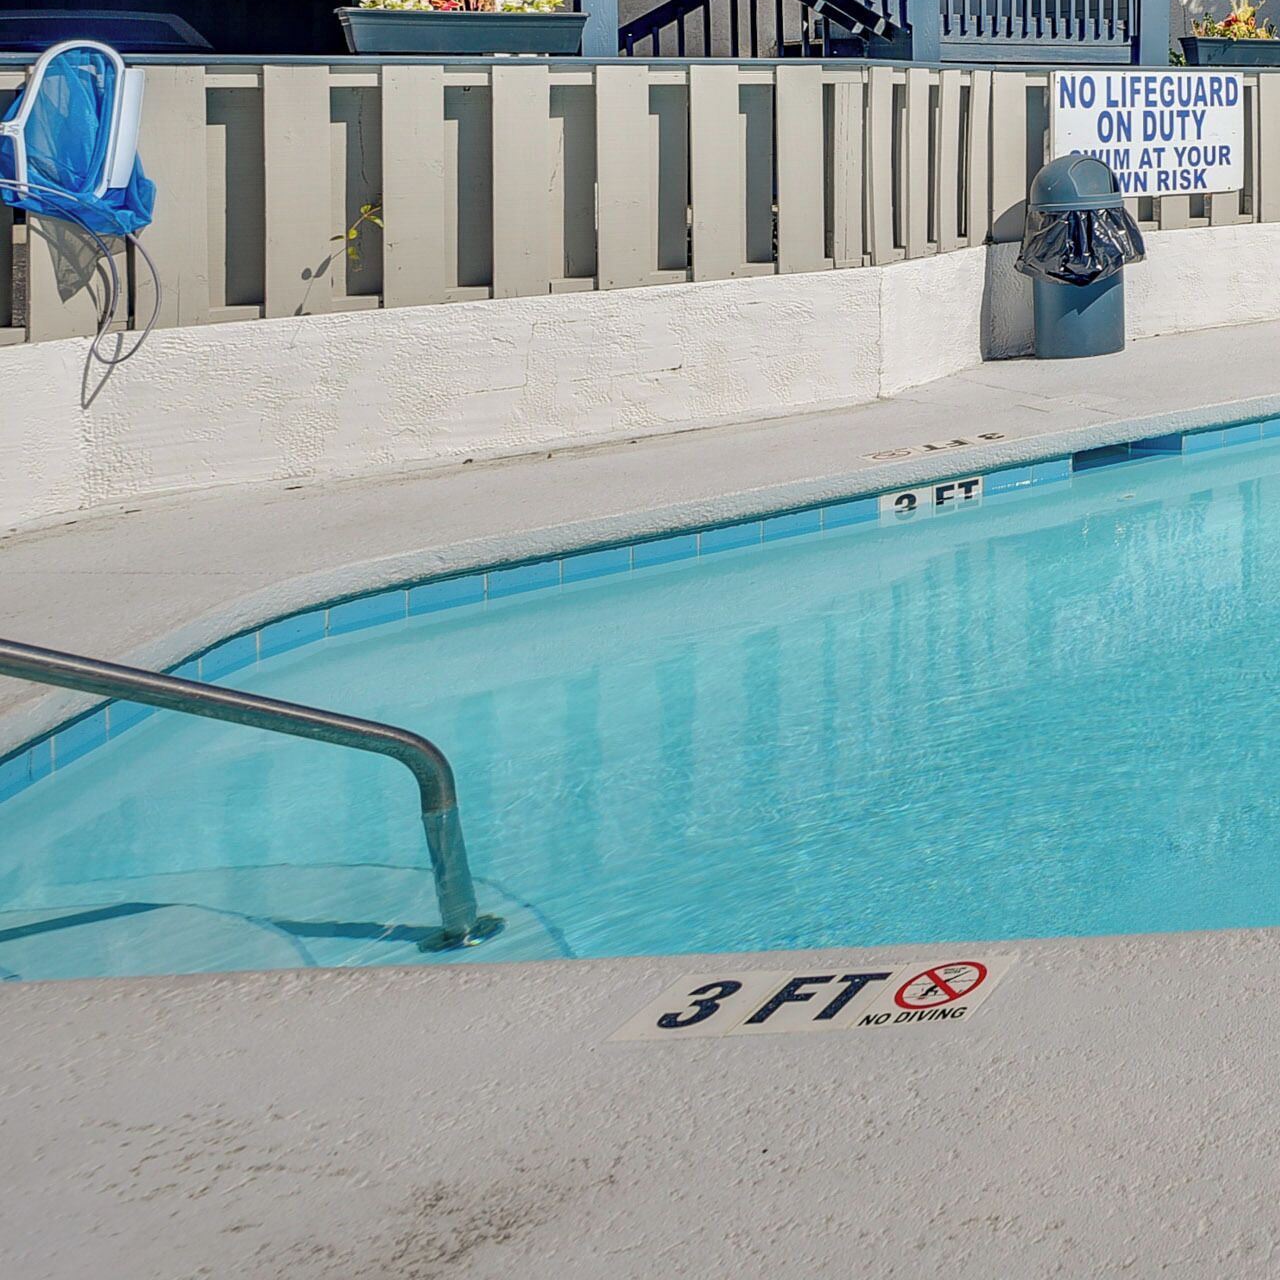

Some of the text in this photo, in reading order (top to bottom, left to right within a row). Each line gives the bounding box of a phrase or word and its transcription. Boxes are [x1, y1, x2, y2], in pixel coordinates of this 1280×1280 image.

[1060, 76, 1238, 109] NO LIFEGUARD
[1097, 110, 1206, 143] ON DUTY
[1139, 147, 1165, 169] AT
[1174, 145, 1231, 167] YOUR
[1157, 169, 1207, 191] RISK
[936, 479, 979, 506] FT
[656, 972, 893, 1029] 3 FT
[858, 1006, 968, 1027] NO DIVING
